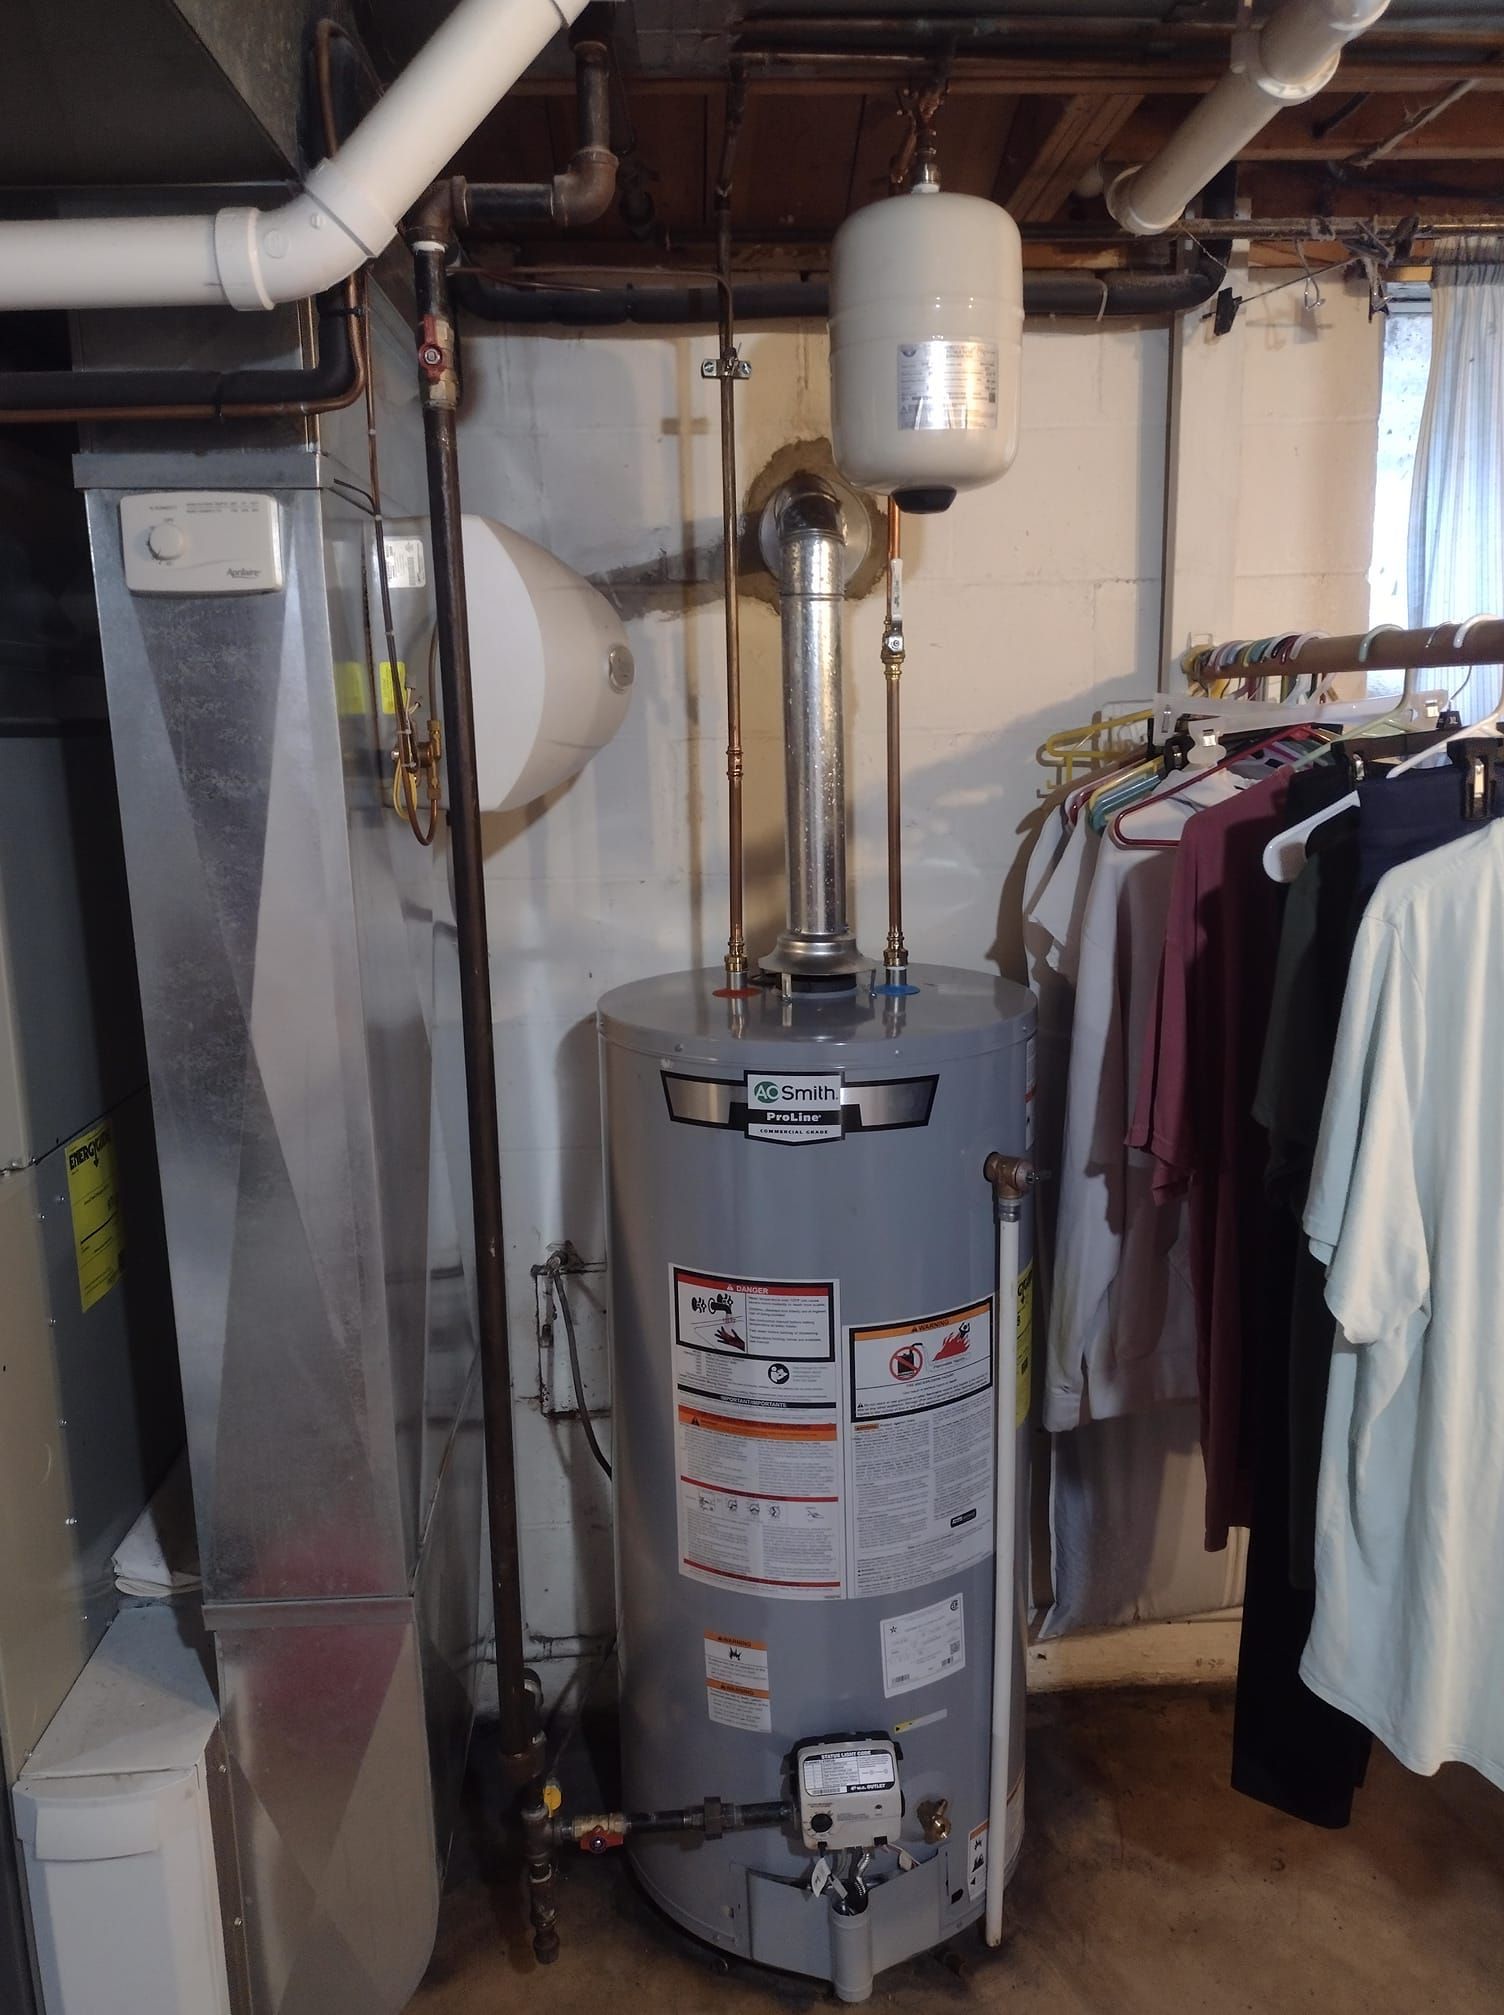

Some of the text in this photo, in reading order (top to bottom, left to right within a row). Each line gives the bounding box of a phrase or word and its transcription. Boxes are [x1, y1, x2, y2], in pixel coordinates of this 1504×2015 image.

[766, 1112, 819, 1122] ProLine
[736, 1285, 769, 1295] DANGER
[918, 1319, 950, 1331] WARNING
[722, 1636, 752, 1648] WARNING
